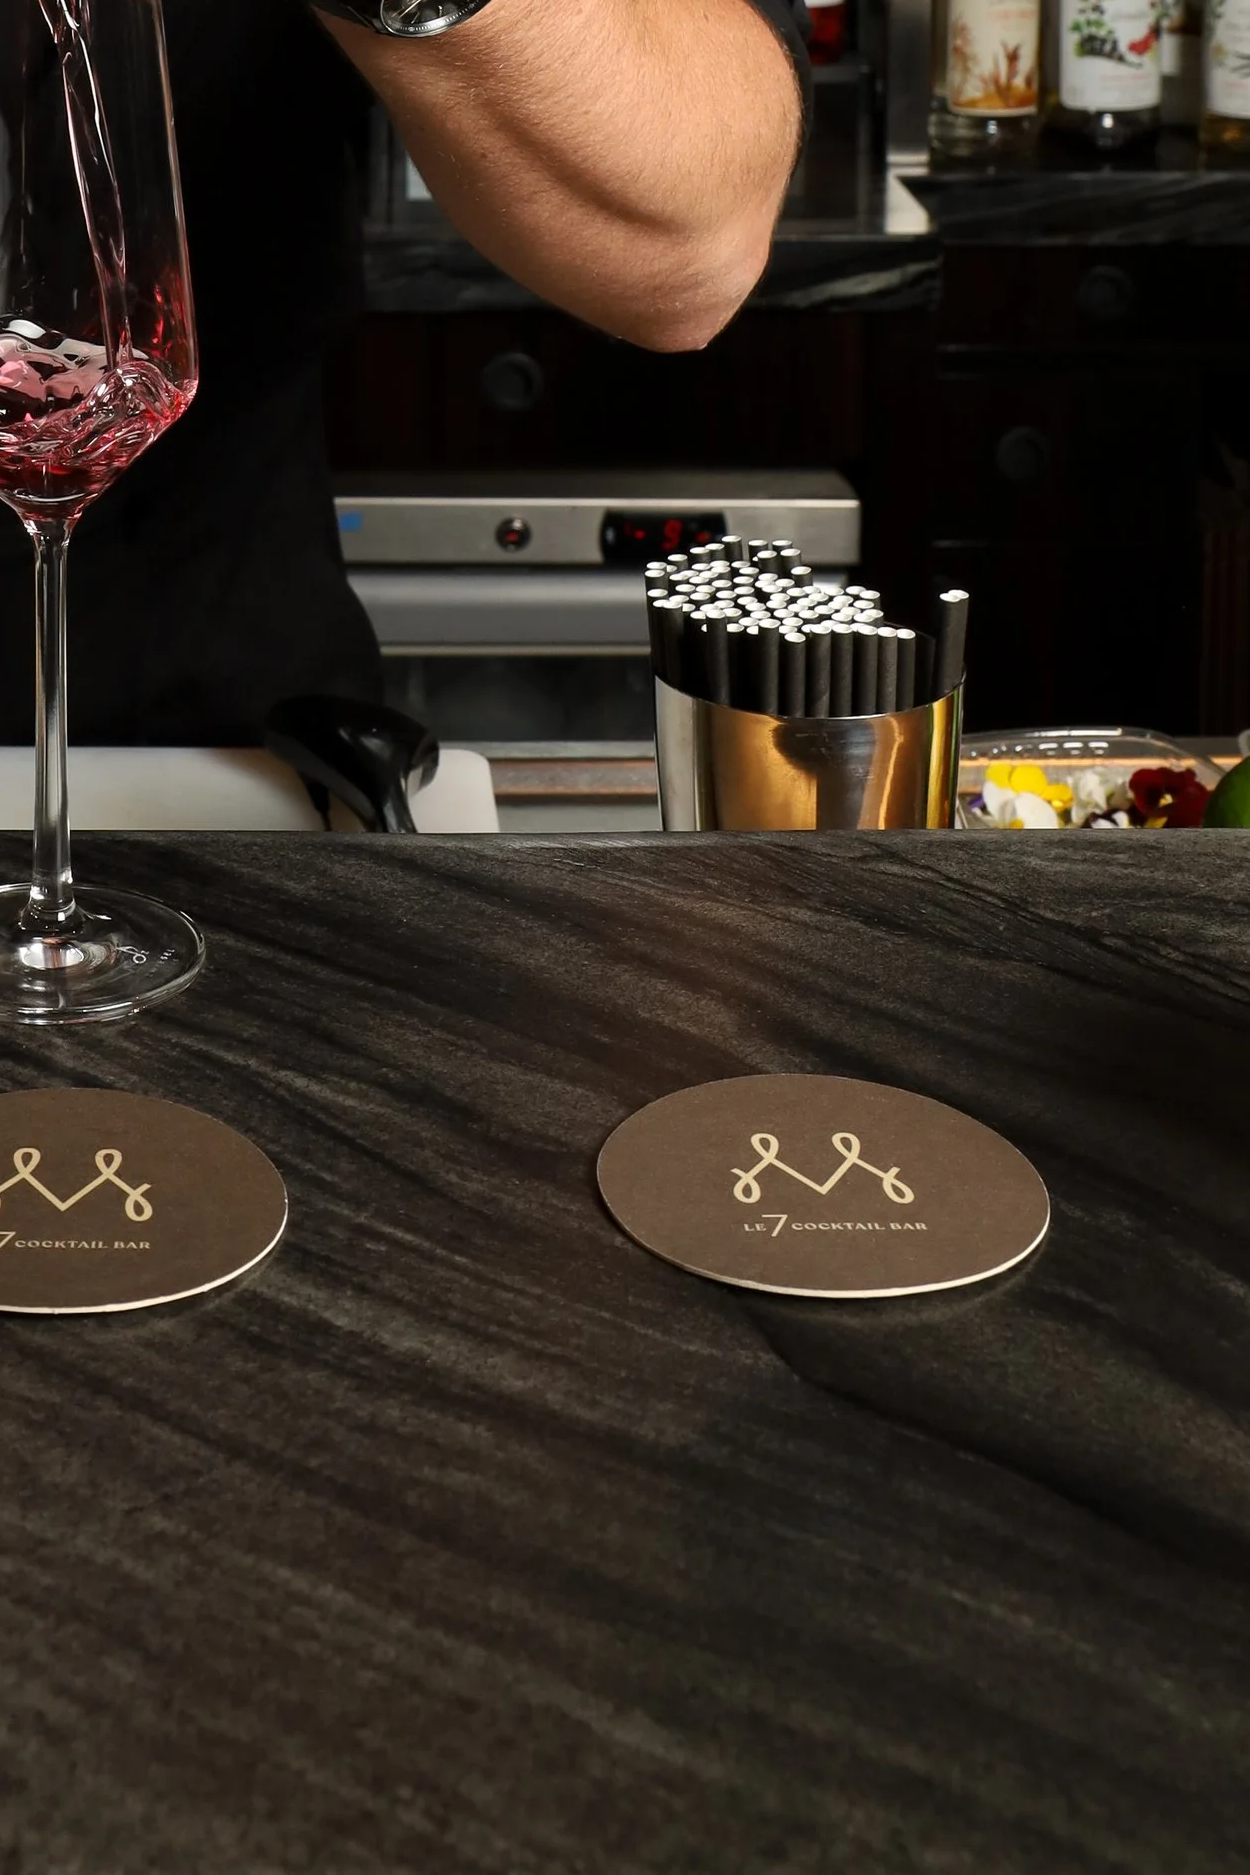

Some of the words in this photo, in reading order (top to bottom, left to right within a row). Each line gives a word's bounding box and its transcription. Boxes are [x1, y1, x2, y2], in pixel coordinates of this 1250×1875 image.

[743, 1223, 767, 1232] LE
[761, 1214, 788, 1237] 7
[791, 1222, 884, 1231] COCKTAIL
[889, 1222, 929, 1231] BAR
[14, 1240, 108, 1249] COCKTAIL
[113, 1240, 151, 1250] BAR
